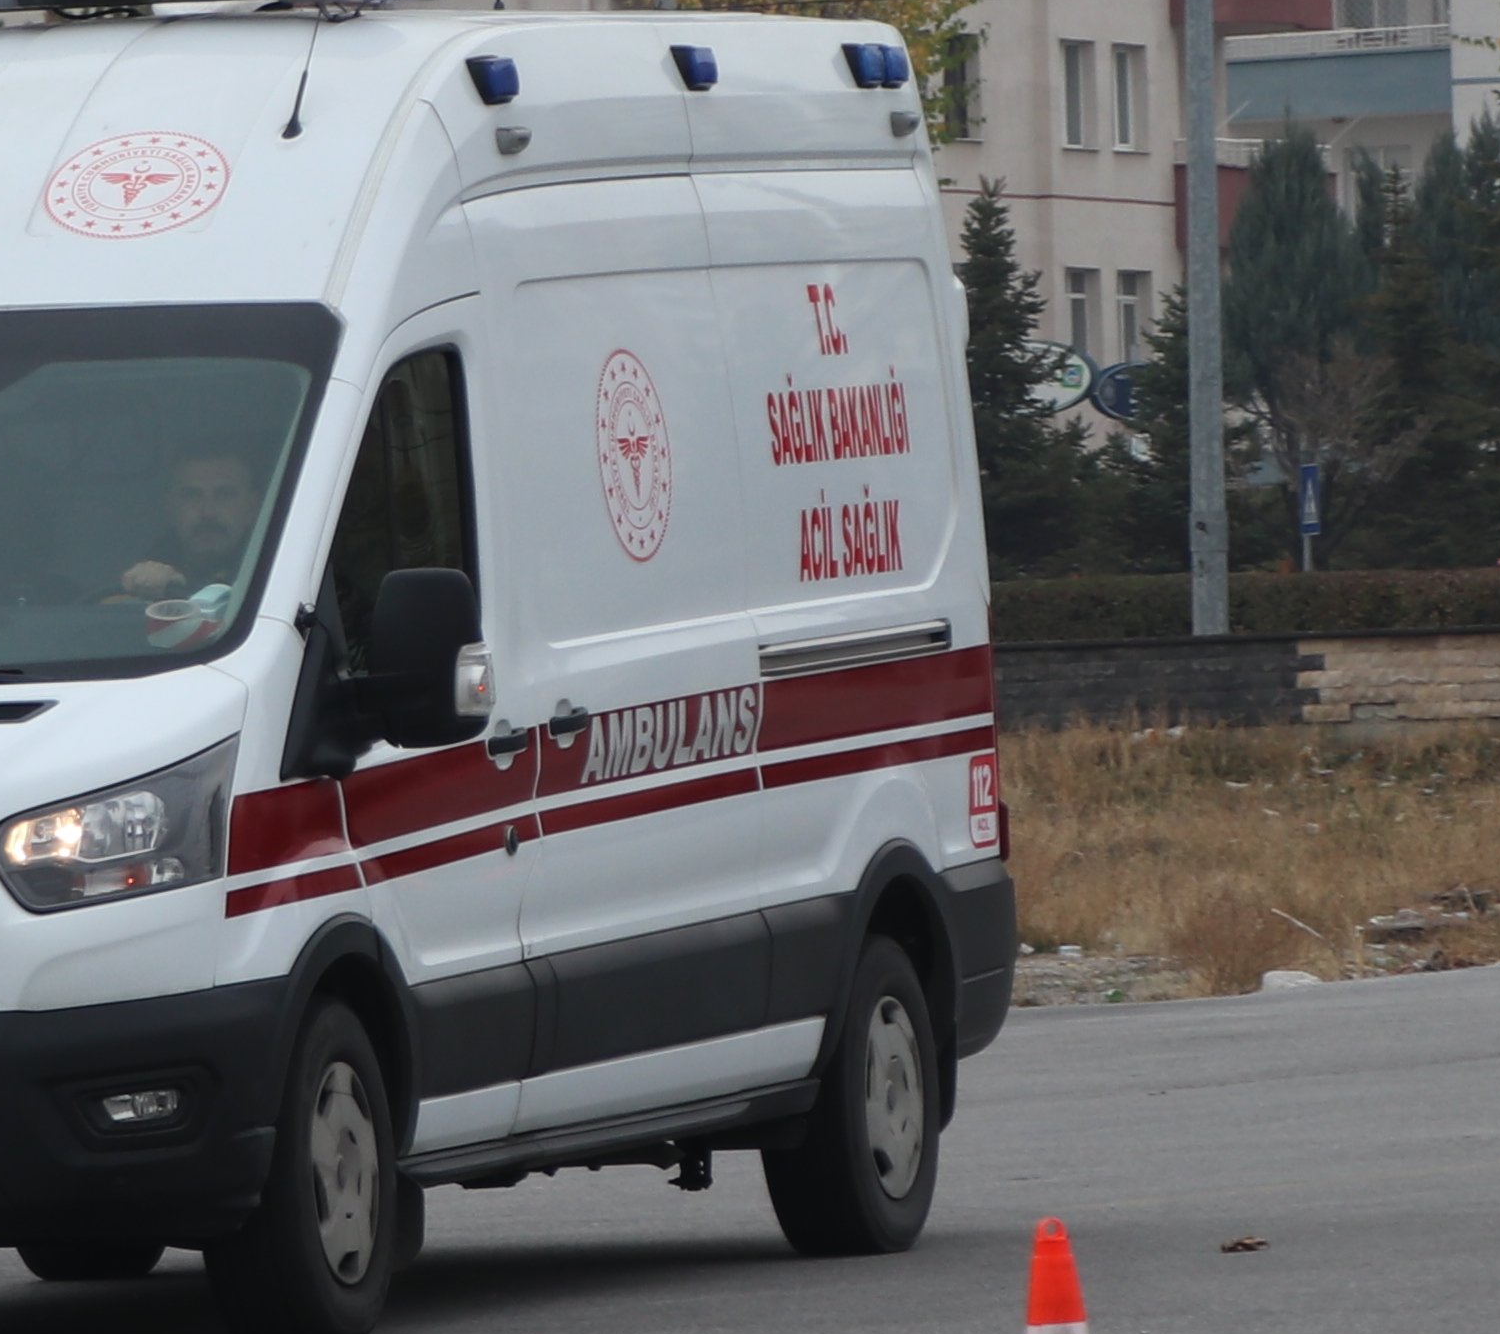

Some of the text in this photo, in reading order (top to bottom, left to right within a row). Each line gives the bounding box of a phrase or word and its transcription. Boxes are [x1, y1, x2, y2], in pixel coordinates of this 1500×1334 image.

[806, 282, 849, 356] T.C.
[766, 372, 829, 466] SAĞLIK
[827, 364, 911, 460] BAKANLIĞI
[800, 483, 903, 582] ACİL SAĞLIK
[580, 685, 757, 785] AMBULANS
[971, 763, 993, 809] 112
